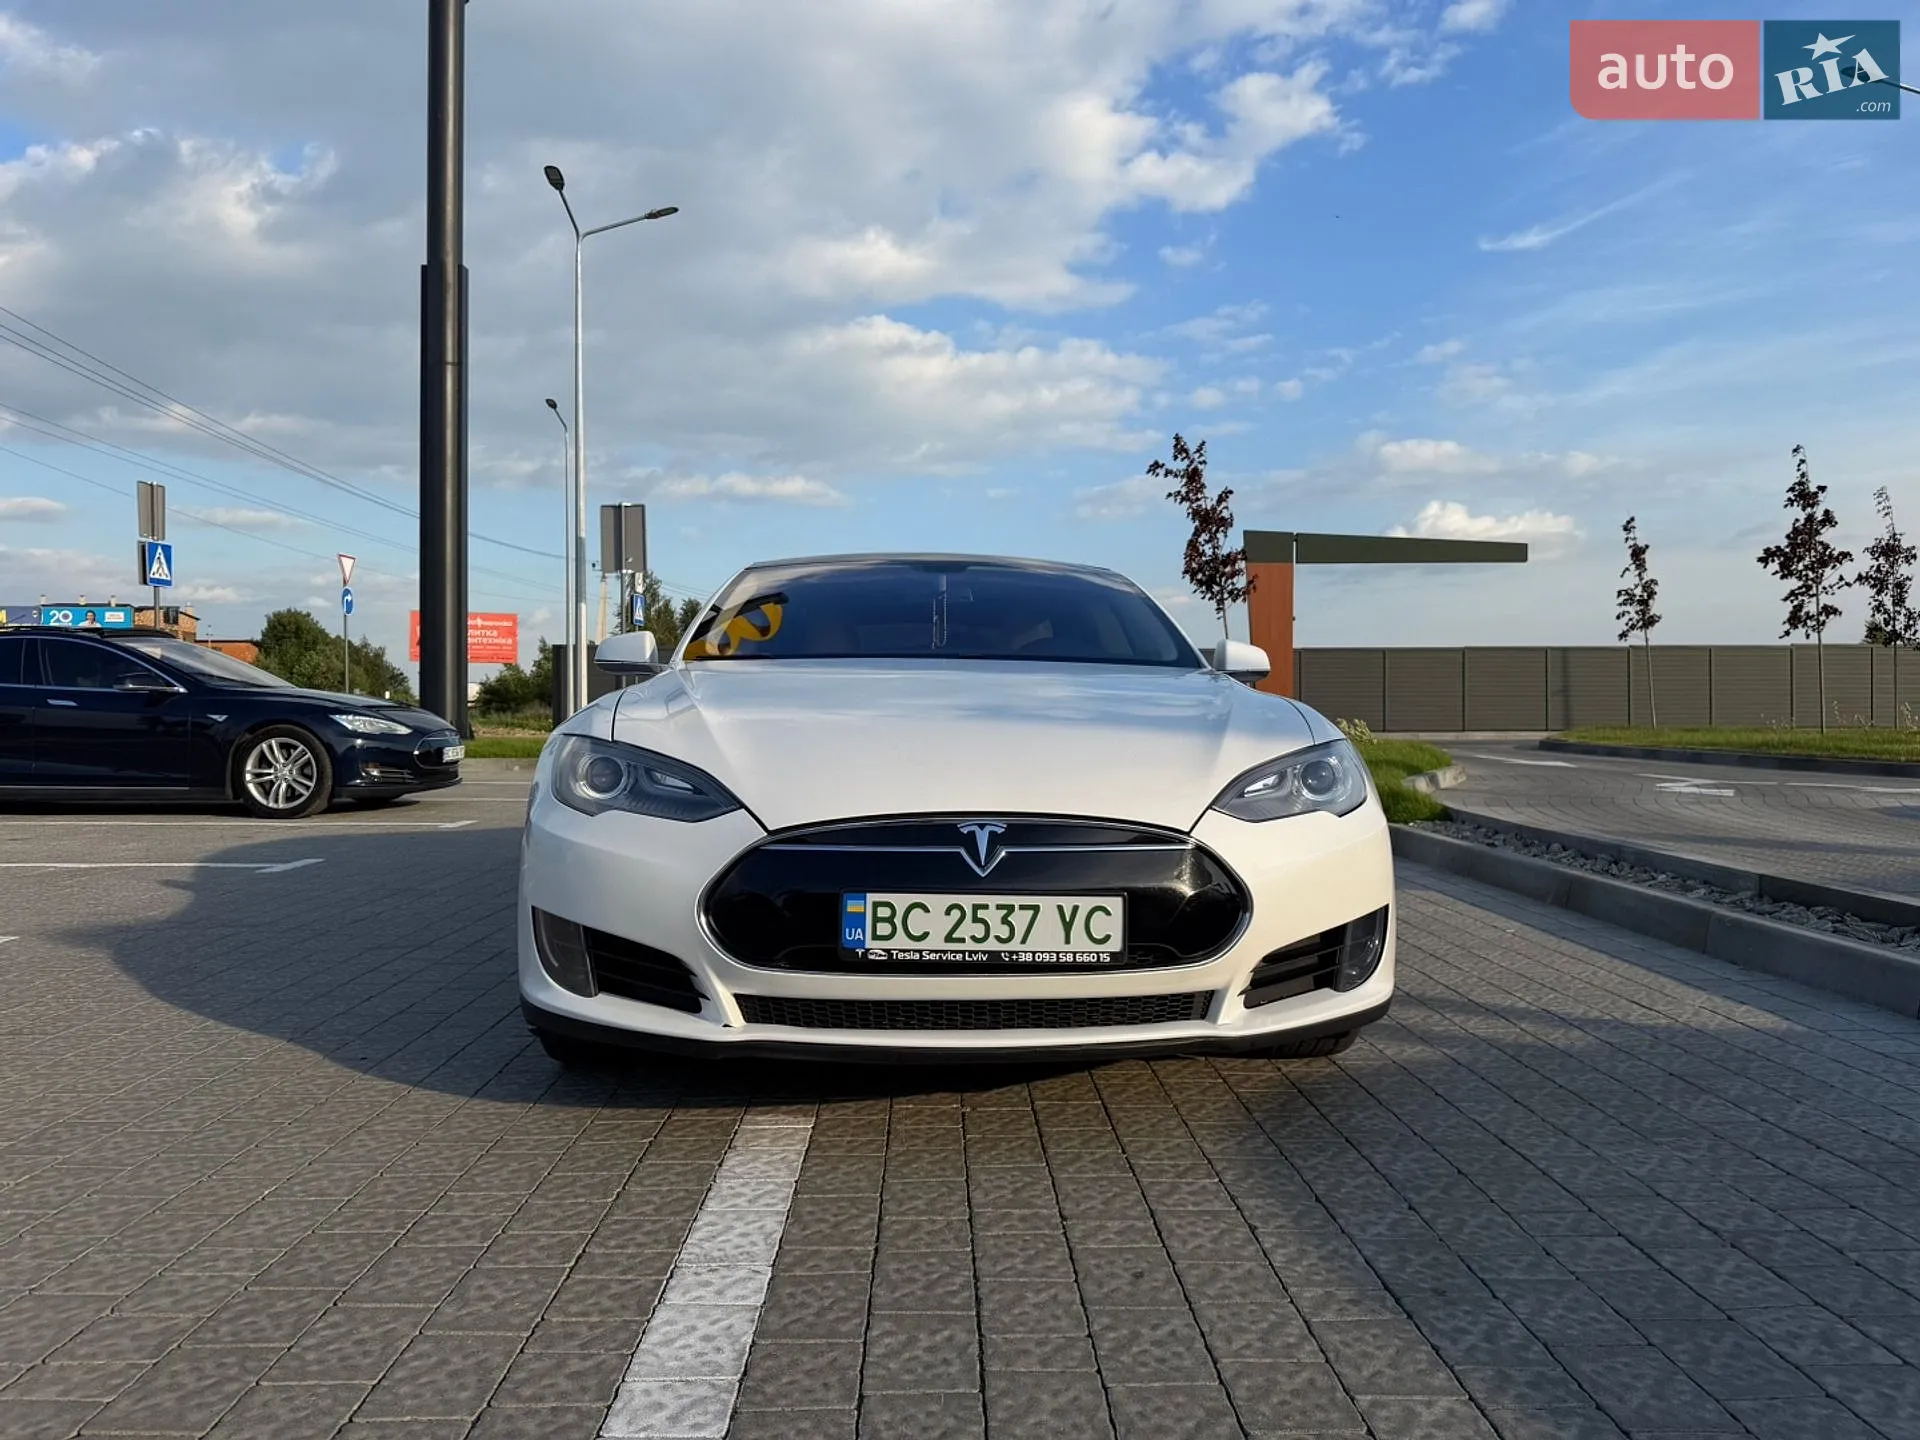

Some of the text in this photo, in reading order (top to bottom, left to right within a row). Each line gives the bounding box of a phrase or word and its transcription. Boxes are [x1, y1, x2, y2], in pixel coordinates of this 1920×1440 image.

[49, 610, 73, 624] 20
[468, 629, 498, 637] литка
[871, 901, 1112, 945] BC 2537 YC
[845, 928, 864, 941] UA
[890, 950, 920, 960] Tesla
[922, 951, 963, 961] Service
[965, 951, 988, 961] Lviv
[1011, 952, 1033, 962] +38
[1035, 953, 1057, 962] 093
[1058, 953, 1074, 962] 58
[1098, 953, 1111, 963] 15
